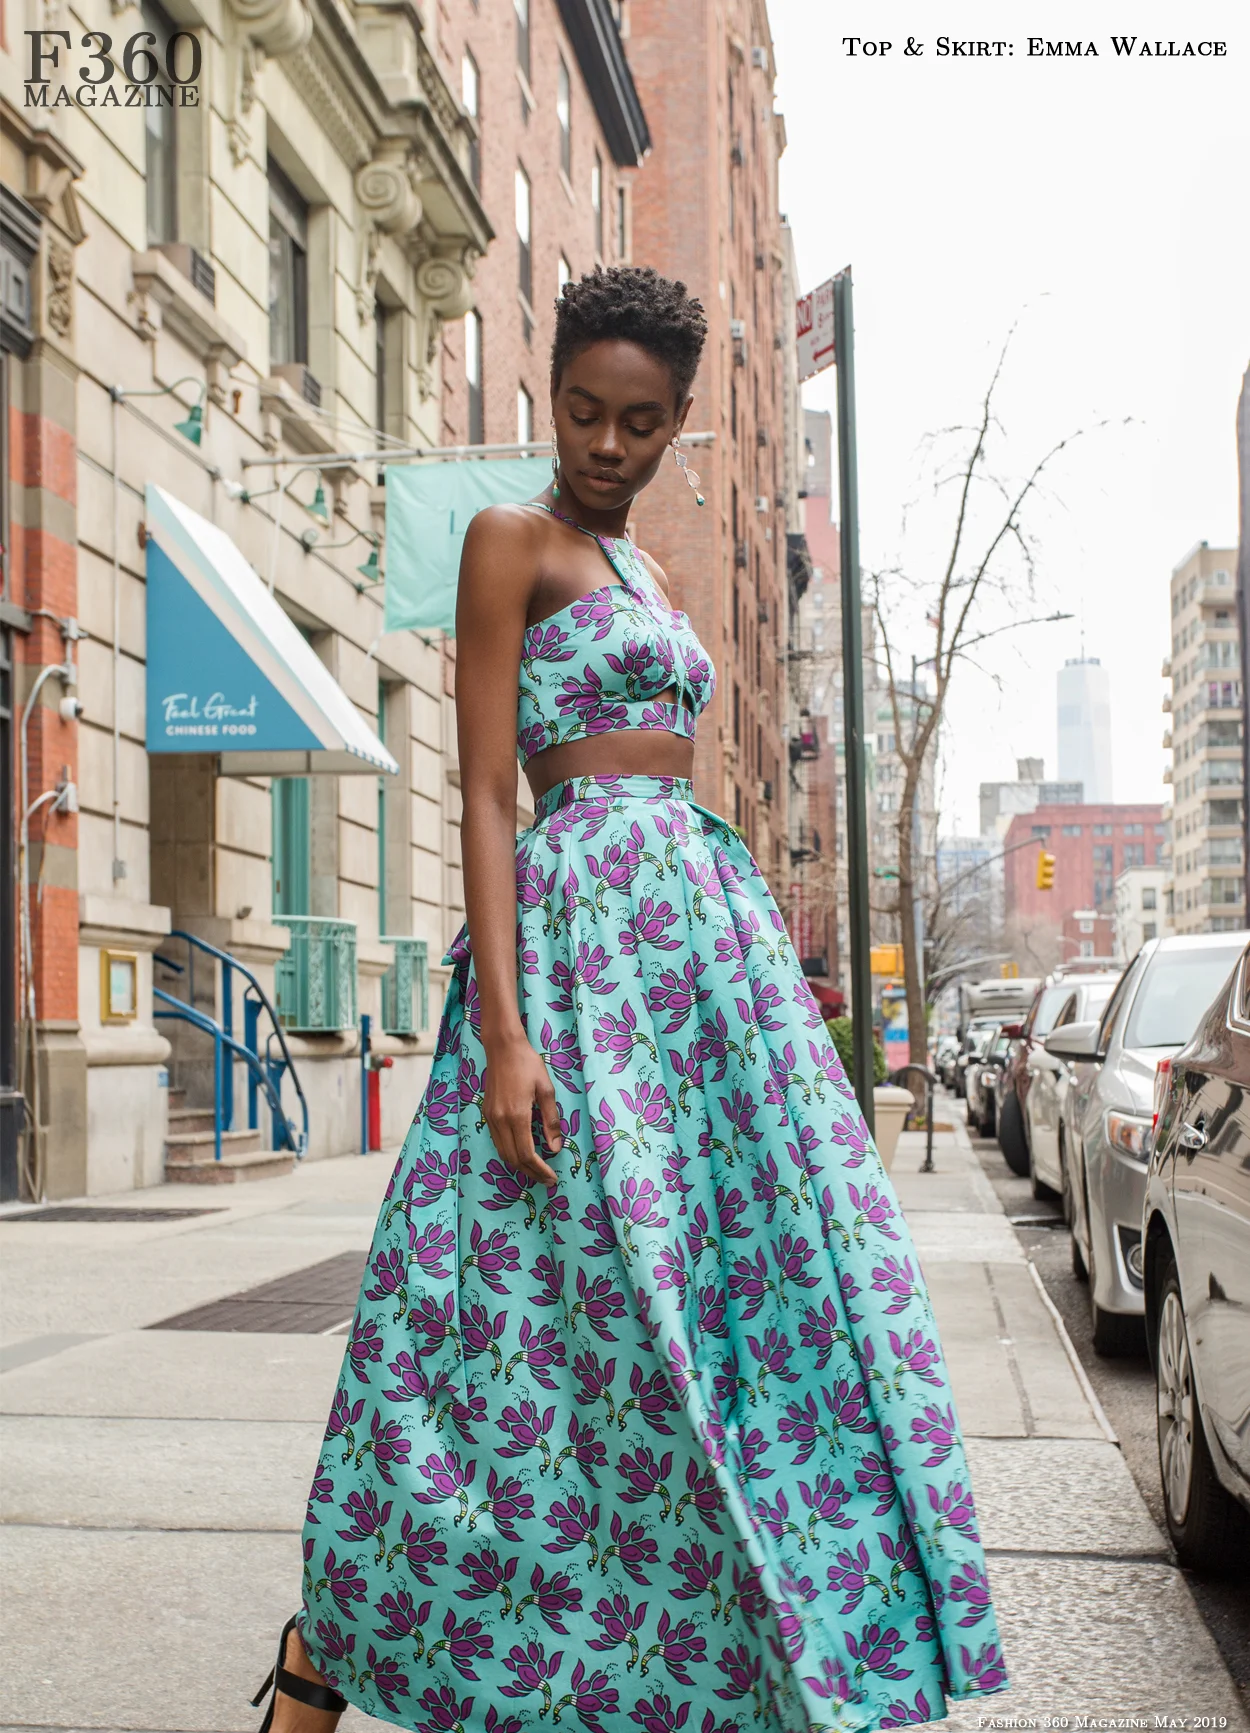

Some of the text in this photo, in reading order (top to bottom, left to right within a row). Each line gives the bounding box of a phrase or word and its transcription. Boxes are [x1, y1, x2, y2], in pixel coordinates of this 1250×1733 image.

[162, 692, 259, 722] Feel Great
[165, 724, 257, 737] CHINESE FOOD
